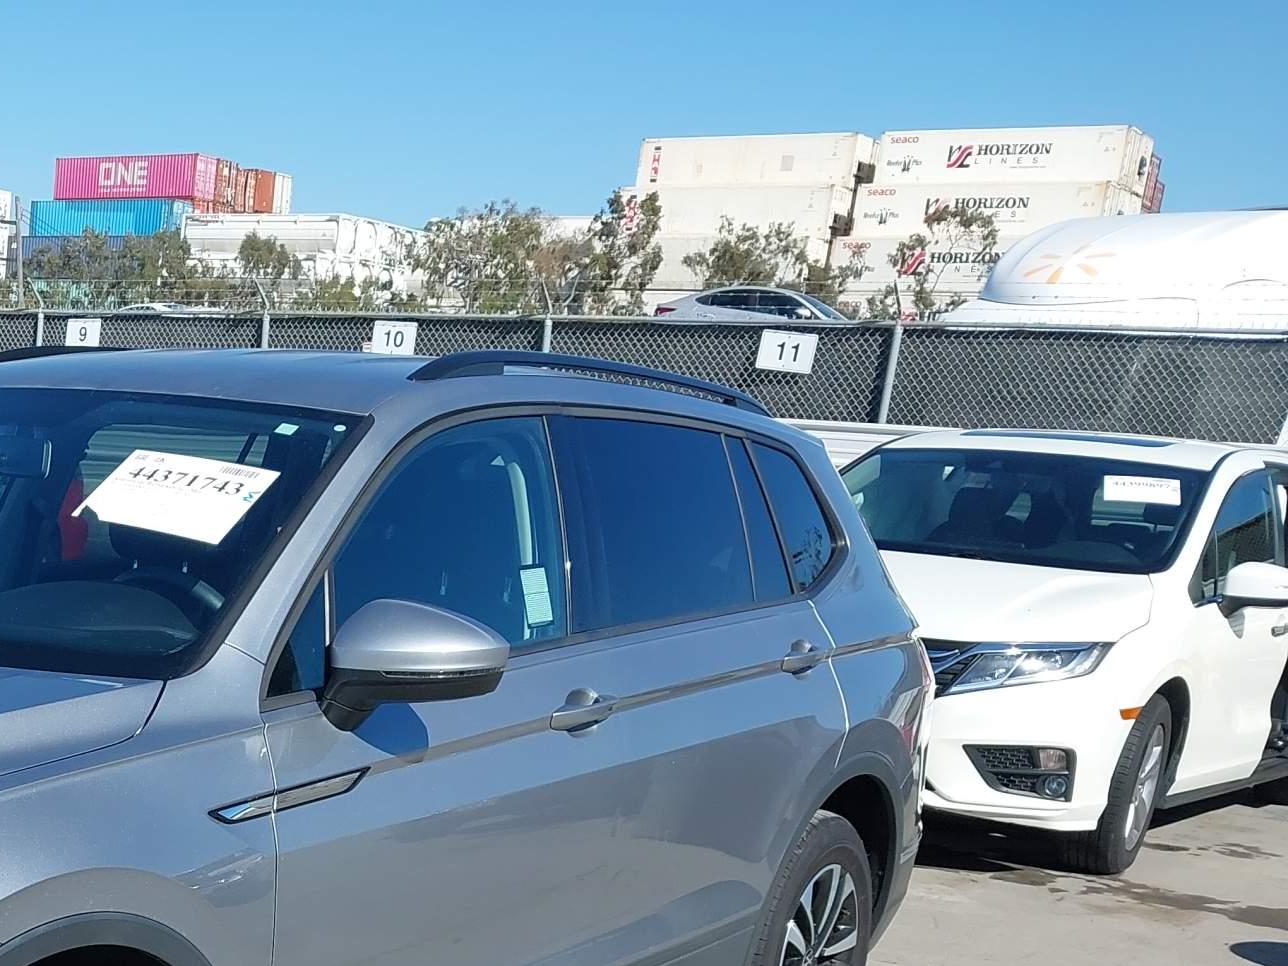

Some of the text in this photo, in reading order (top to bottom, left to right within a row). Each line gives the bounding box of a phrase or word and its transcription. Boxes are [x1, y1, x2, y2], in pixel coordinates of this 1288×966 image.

[890, 136, 920, 144] seaco
[976, 142, 1054, 156] HORIZON
[974, 156, 1040, 166] LINES
[98, 160, 149, 186] ONE
[867, 188, 897, 197] seaco
[954, 197, 1031, 209] HORIZON
[78, 326, 88, 342] 9
[384, 329, 405, 348] 10
[776, 340, 801, 363] 11
[128, 465, 246, 496] 44371743
